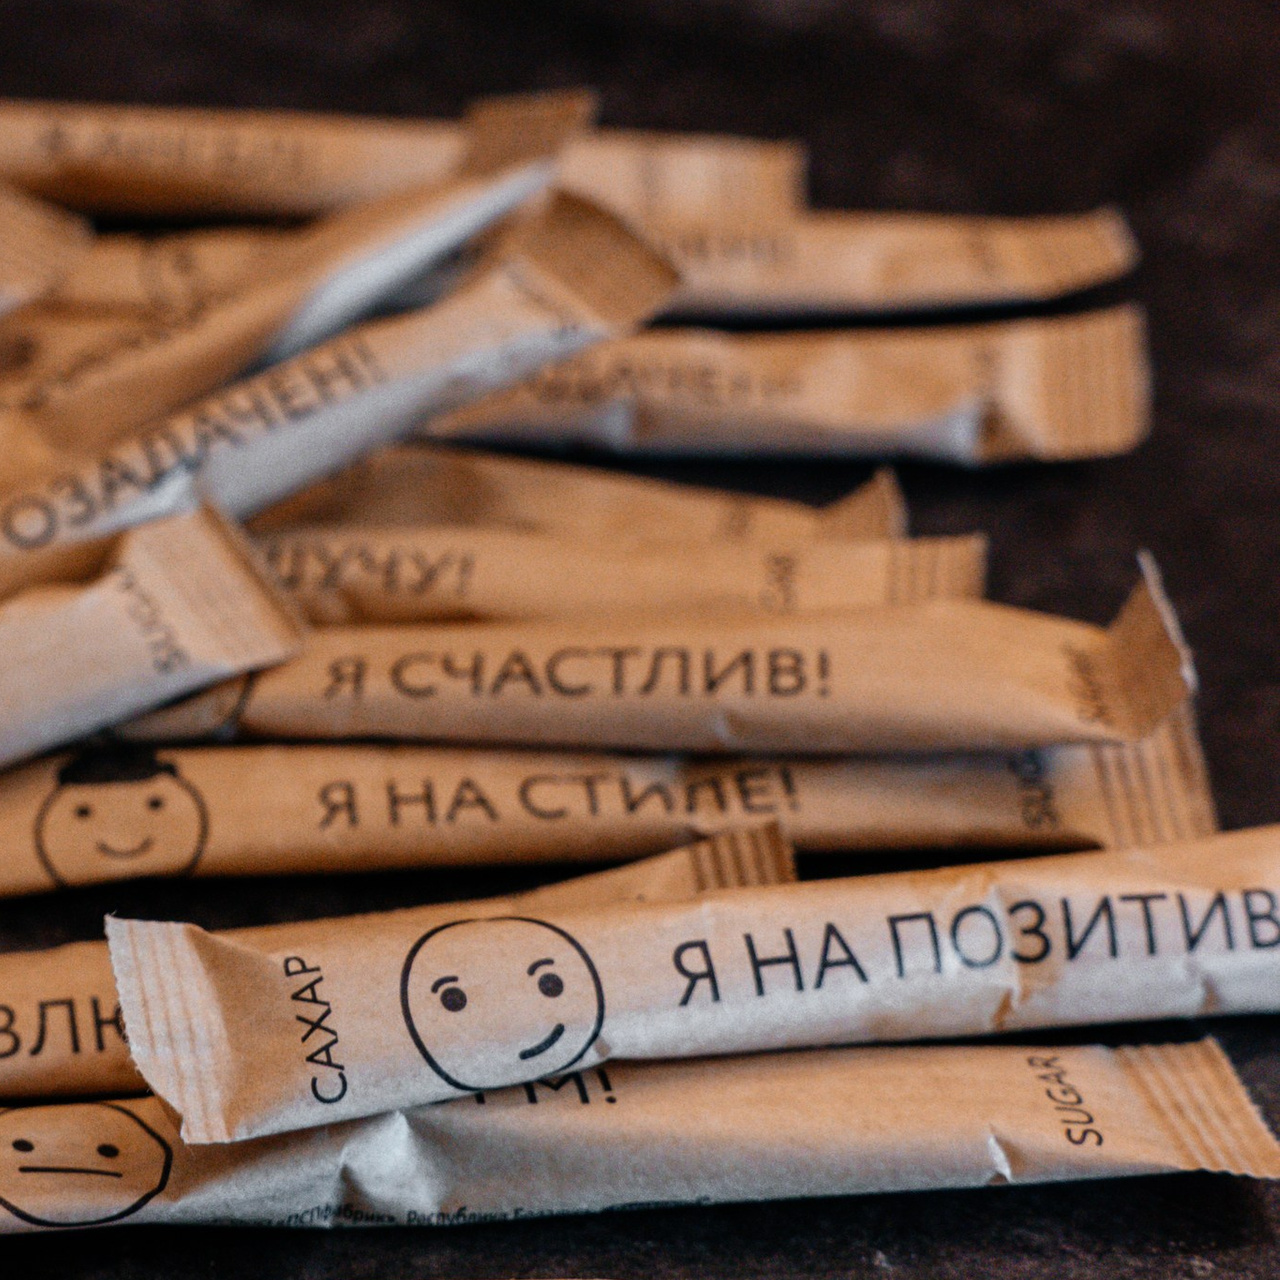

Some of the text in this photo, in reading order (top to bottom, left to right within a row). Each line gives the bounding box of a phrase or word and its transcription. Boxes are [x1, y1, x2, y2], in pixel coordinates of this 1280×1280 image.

[0, 337, 387, 550] ОЗАДАЧЕН!
[322, 645, 832, 700] Я СЧАСТЛИВ!
[317, 779, 359, 829] Я
[386, 775, 501, 824] НА
[671, 939, 721, 1007] Я
[743, 922, 869, 997] НА
[283, 955, 348, 1104] САХАР
[1026, 1056, 1104, 1147] SUGAR
